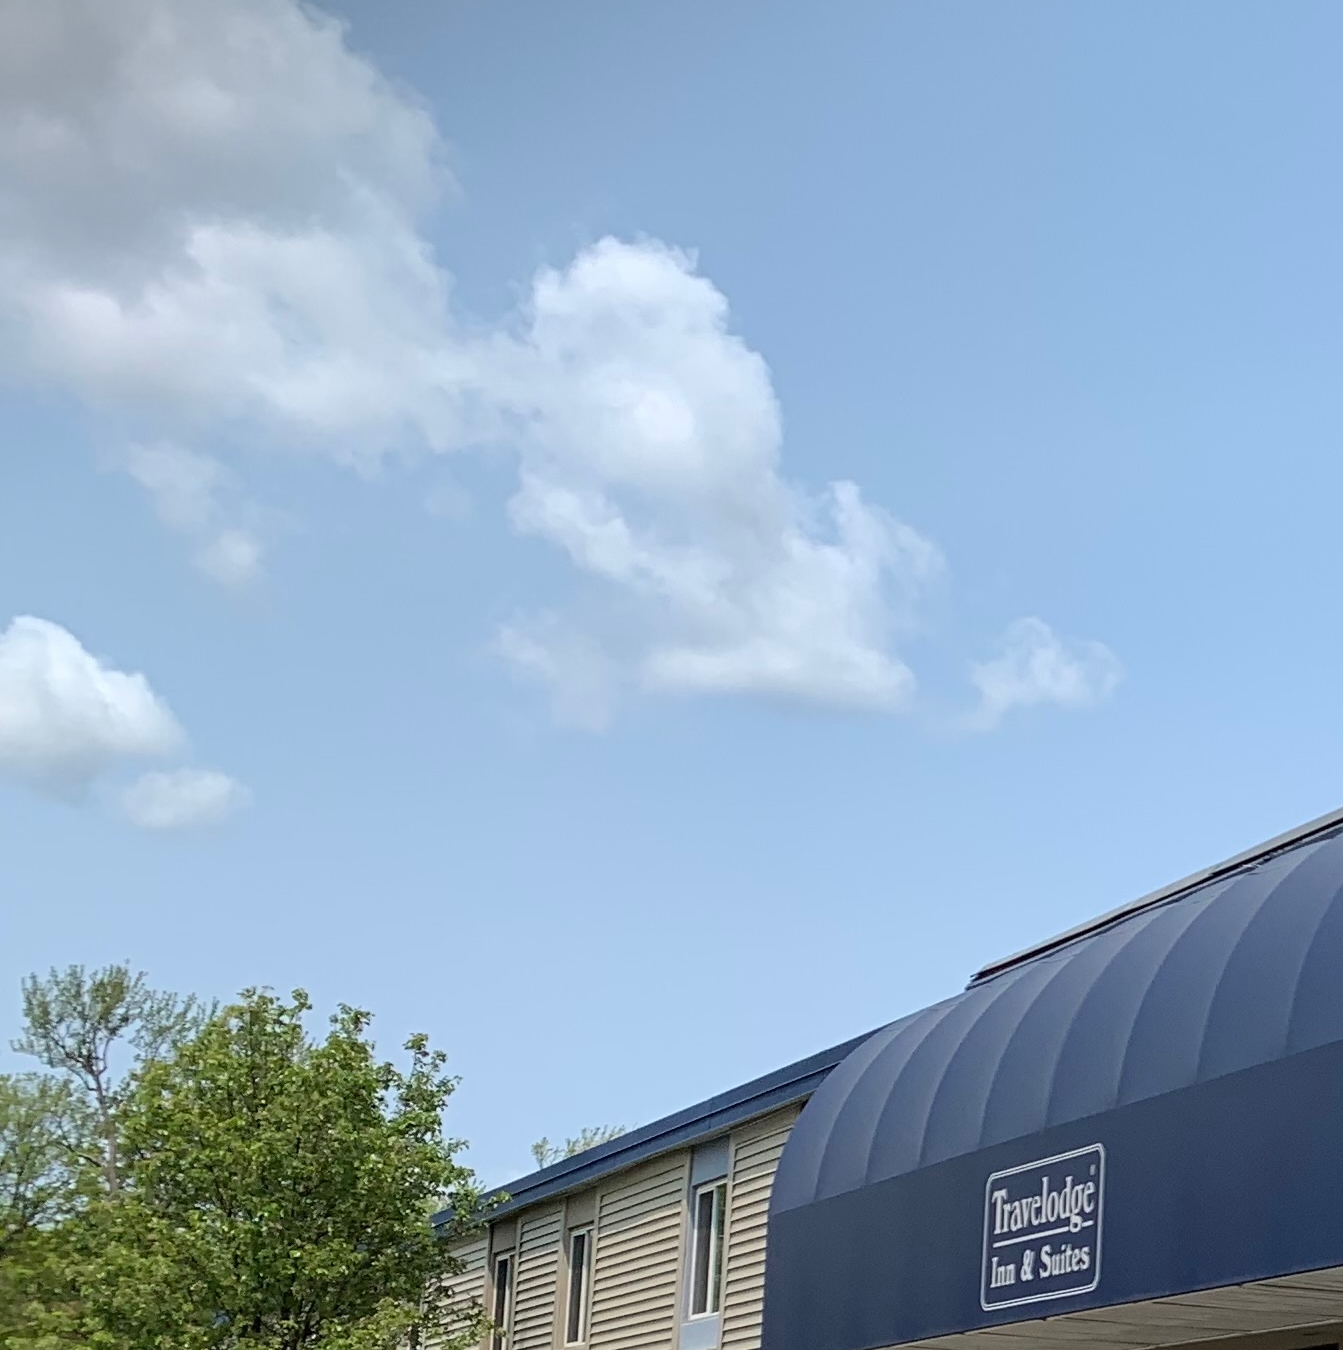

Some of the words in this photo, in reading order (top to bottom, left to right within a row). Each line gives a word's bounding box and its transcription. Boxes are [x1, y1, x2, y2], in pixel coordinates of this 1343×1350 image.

[992, 1176, 1095, 1233] Travelodge
[990, 1257, 1016, 1288] Inn
[1020, 1250, 1036, 1281] &
[1039, 1244, 1090, 1278] Suites
